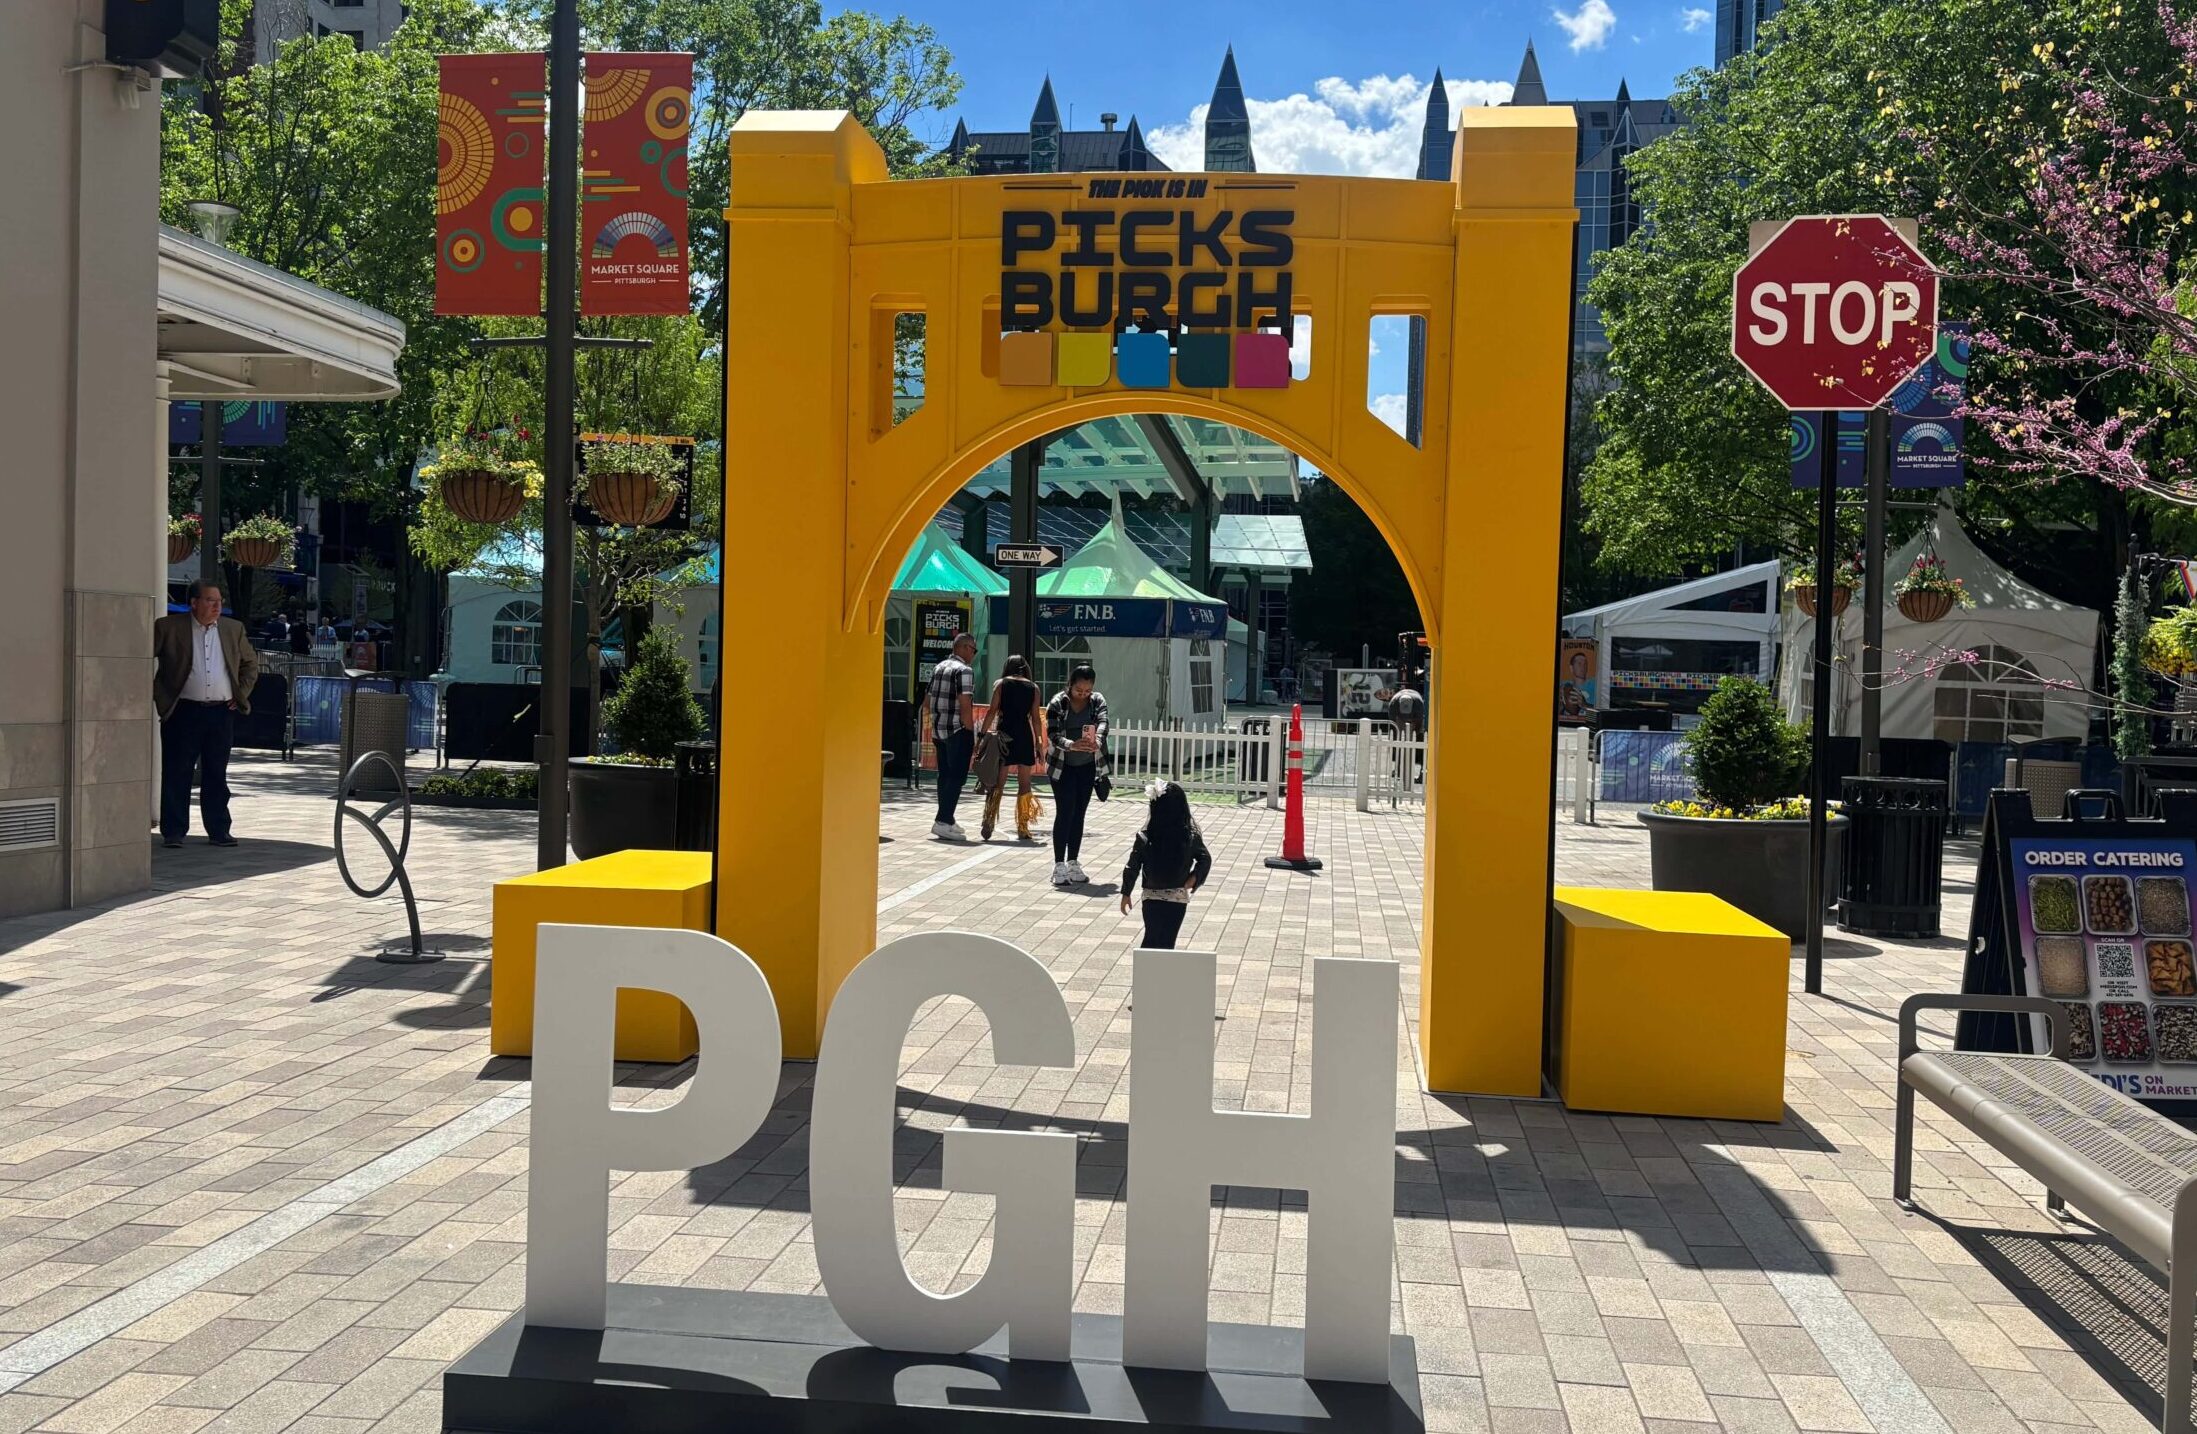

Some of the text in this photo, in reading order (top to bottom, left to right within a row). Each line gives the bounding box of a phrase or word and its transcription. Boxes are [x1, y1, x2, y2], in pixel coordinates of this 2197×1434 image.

[1088, 179, 1122, 199] THE
[1165, 179, 1186, 199] IS
[1186, 179, 1208, 199] IN
[1001, 210, 1295, 267] PICKS
[591, 263, 680, 275] MARKET SQUARE
[614, 277, 657, 285] PITTSBURGH
[1000, 271, 1293, 328] BURGH
[1748, 280, 1921, 346] STOP
[1896, 455, 1928, 463] MARKET
[1001, 551, 1042, 561] ONE WAY
[925, 613, 960, 622] PICKS
[1074, 604, 1117, 621] F.N.B.
[925, 620, 960, 630] BURGH
[1067, 626, 1077, 634] get
[922, 638, 954, 649] WELCOM
[1564, 641, 1595, 650] HOUSTON
[2024, 850, 2184, 867] ORDER CATERING
[2144, 1075, 2164, 1085] ON
[2145, 1085, 2197, 1096] MARKET
[523, 921, 1400, 1385] PGH
